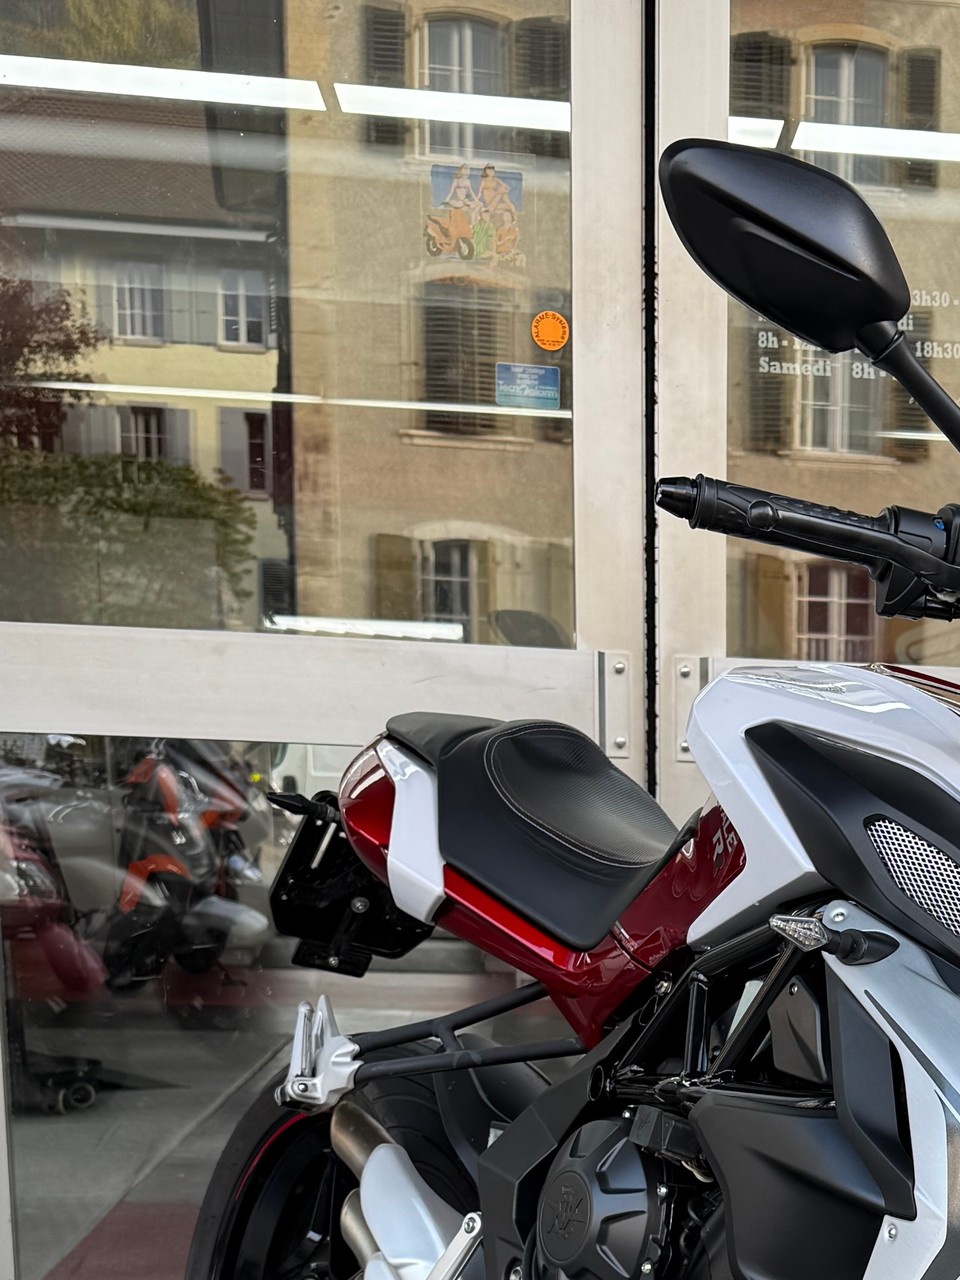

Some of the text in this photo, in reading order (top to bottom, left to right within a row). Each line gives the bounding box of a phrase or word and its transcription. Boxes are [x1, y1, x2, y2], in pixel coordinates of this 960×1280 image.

[911, 290, 950, 308] 3h30
[758, 331, 779, 349] 8h
[759, 356, 832, 377] Samedi
[852, 362, 876, 380] 8h
